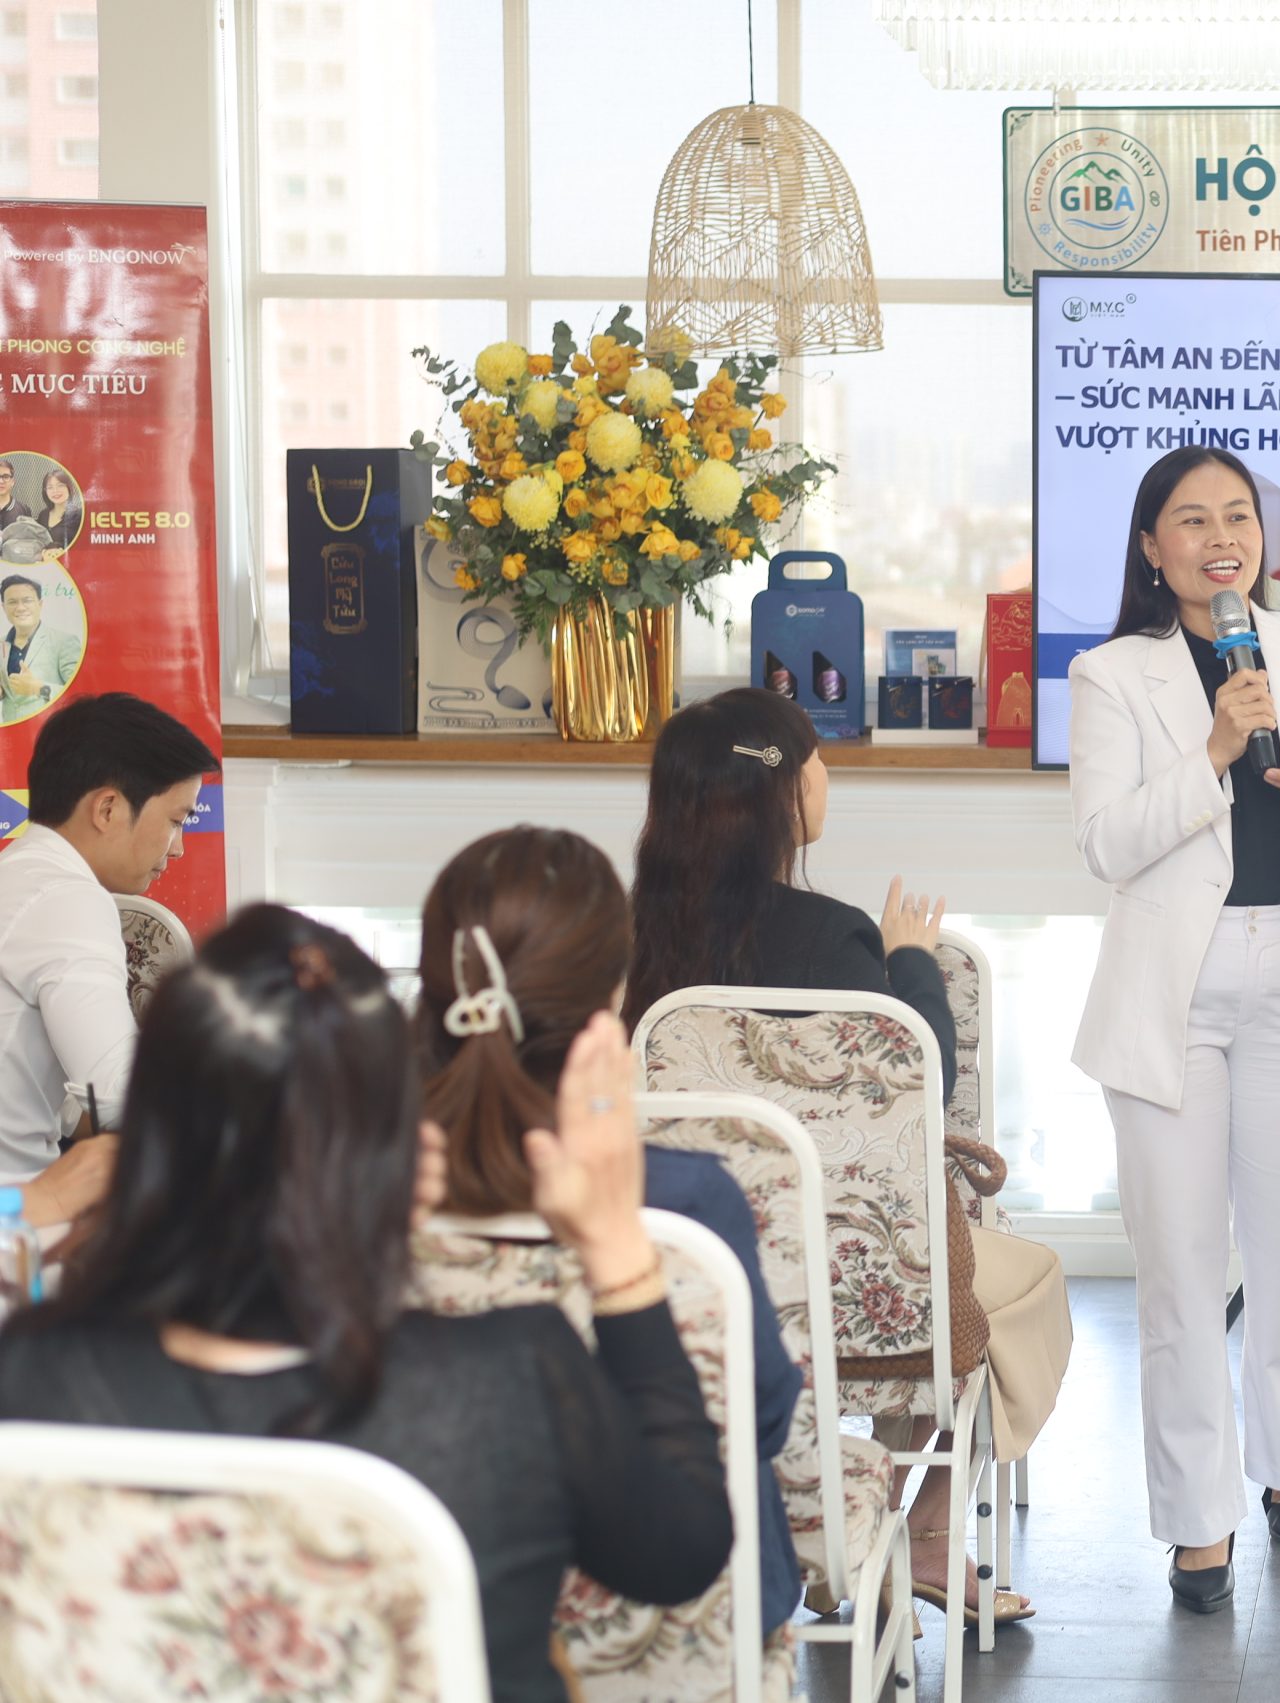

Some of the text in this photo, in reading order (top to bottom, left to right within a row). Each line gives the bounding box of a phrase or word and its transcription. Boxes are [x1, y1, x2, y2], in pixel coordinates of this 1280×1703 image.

[1121, 139, 1156, 178] Unity
[1030, 138, 1084, 213] Pioneering
[1060, 185, 1135, 212] GIBA
[1053, 222, 1158, 267] Responsibility
[1196, 229, 1246, 251] Tiên
[4, 249, 185, 265] Powered by ENGONOW
[7, 339, 73, 354] PHONG
[137, 337, 186, 358] NGHỆ
[1055, 337, 1099, 369] TỪ
[1102, 338, 1165, 369] TÂM
[1171, 346, 1213, 370] AN
[1219, 340, 1280, 371] ĐẾN
[11, 373, 76, 398] MỤC
[83, 369, 147, 395] TIÊU
[1081, 378, 1141, 409] SỨC
[1148, 386, 1235, 416] MẠNH
[1055, 421, 1140, 455] VƯỢT
[1146, 419, 1250, 451] KHỦNG
[90, 511, 191, 529] IELTS 8.0
[90, 533, 156, 544] MINH ANH
